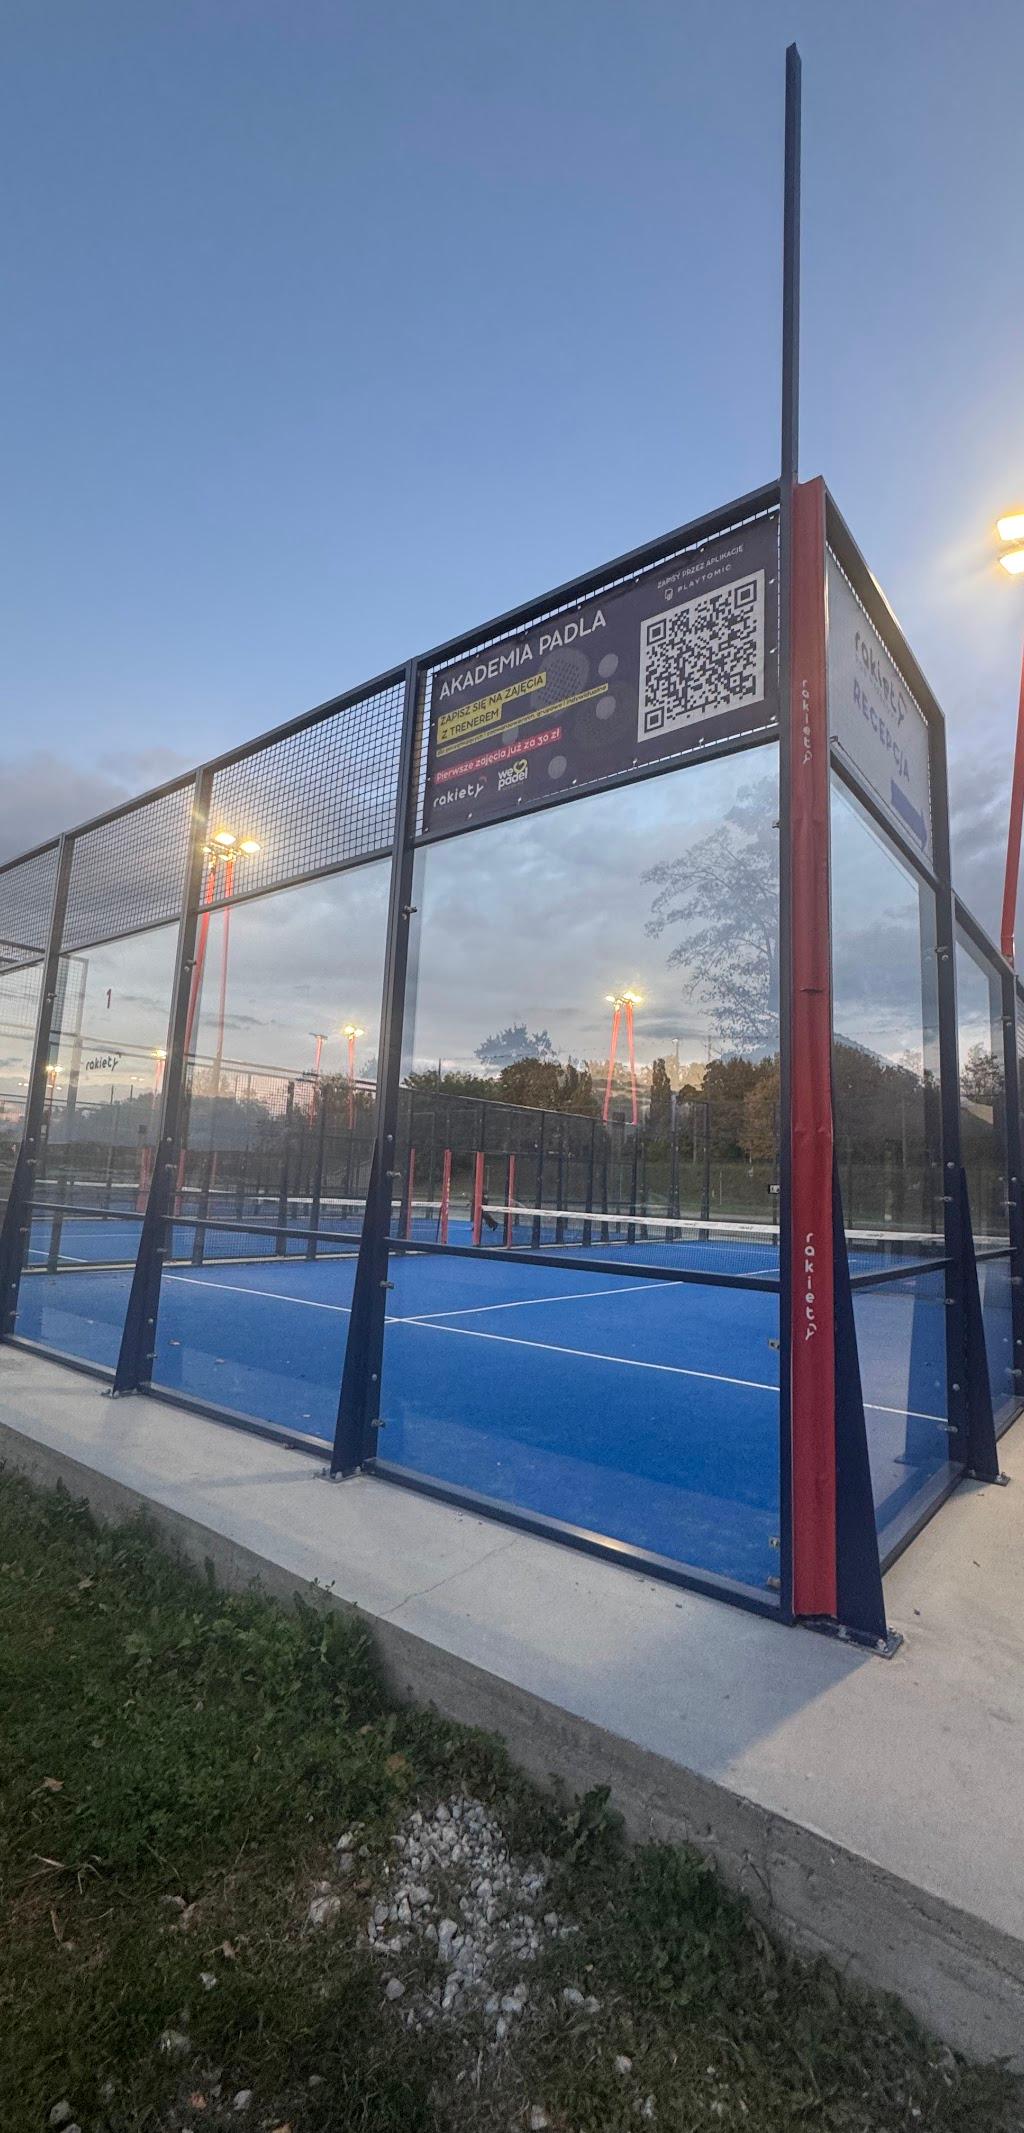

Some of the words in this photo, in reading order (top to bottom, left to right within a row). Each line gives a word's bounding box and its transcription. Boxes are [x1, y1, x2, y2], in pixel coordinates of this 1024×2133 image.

[657, 572, 680, 589] ZAPISY
[682, 562, 705, 577] PRZEZ
[677, 564, 732, 592] PLAYTOMIC
[439, 644, 533, 700] AKADEMIA
[539, 609, 606, 656] PADLA
[855, 631, 906, 728] rakiety
[440, 705, 471, 726] ZAPISZ
[472, 699, 486, 713] SIĘ
[489, 693, 502, 705] NA
[504, 676, 543, 699] ZAJĘCIA
[441, 729, 448, 740] Z
[450, 708, 499, 736] TRENEREM
[801, 680, 813, 765] rakiety
[853, 677, 910, 783] RECEPCJA
[436, 761, 474, 782] Pierwsze
[475, 750, 506, 767] zajęcia
[506, 742, 522, 759] już
[523, 738, 536, 750] za
[537, 735, 549, 746] 30
[498, 768, 513, 779] we
[433, 782, 484, 808] rakiety
[498, 767, 528, 791] padel
[106, 988, 112, 1009] 1
[85, 1055, 118, 1072] rakiety
[804, 1232, 817, 1341] rakiety
